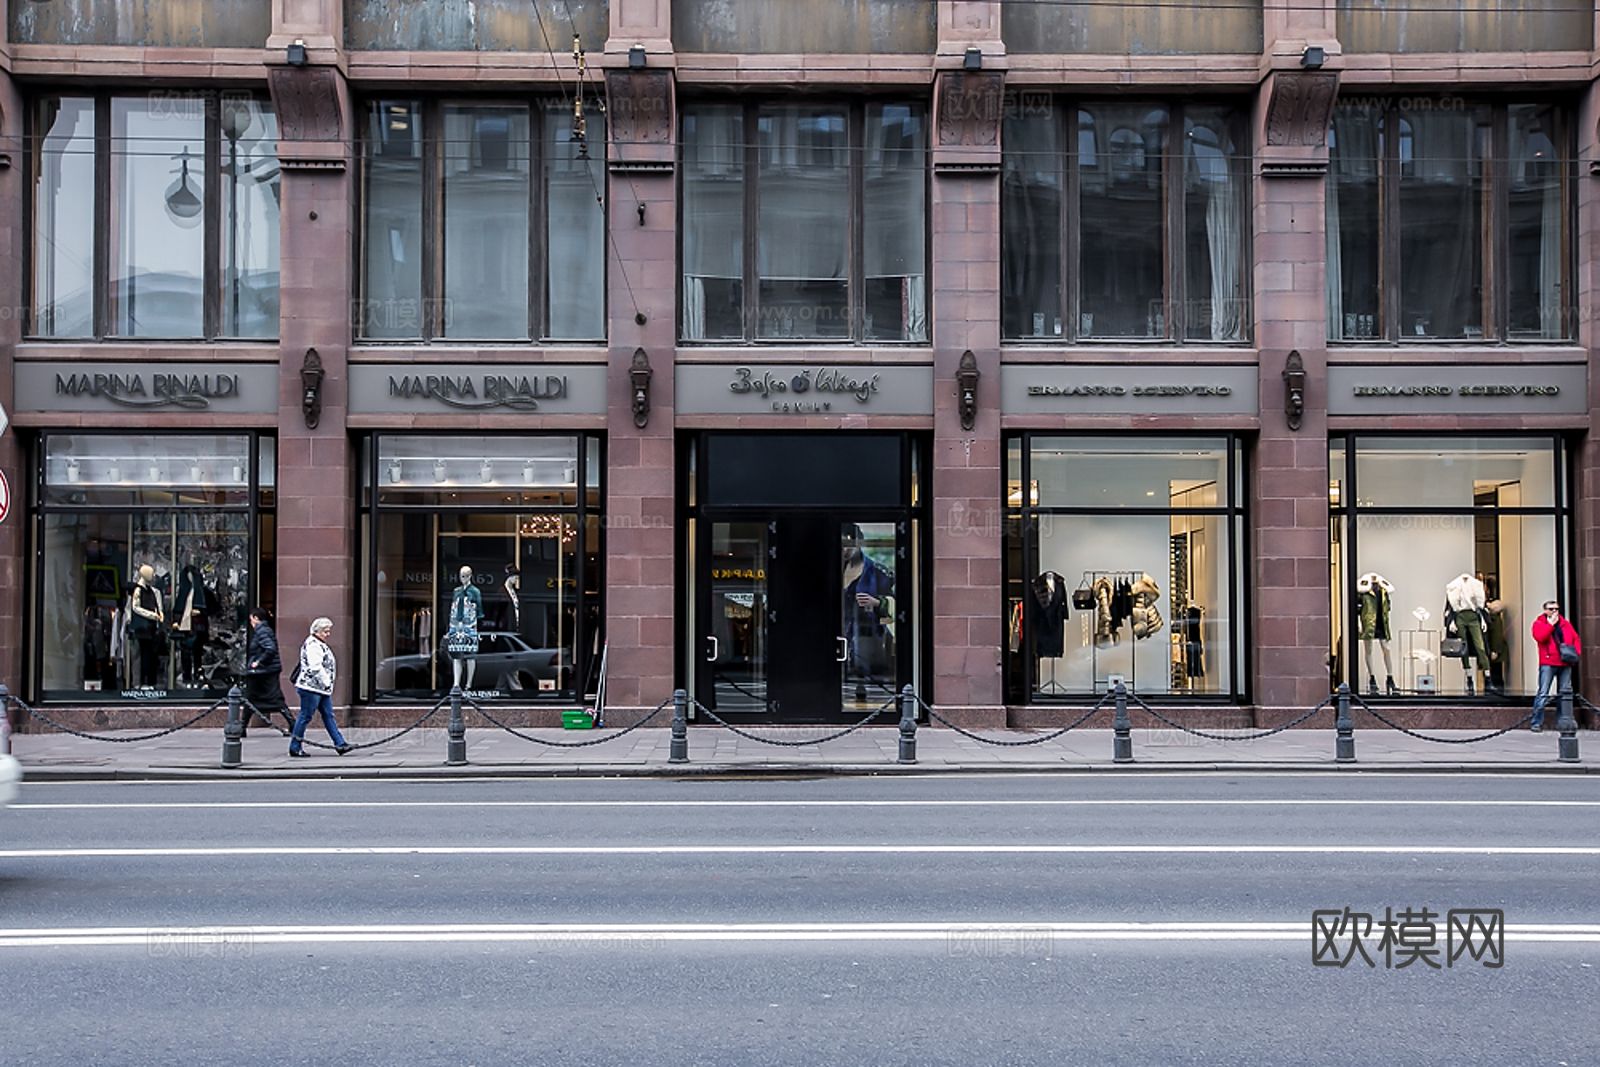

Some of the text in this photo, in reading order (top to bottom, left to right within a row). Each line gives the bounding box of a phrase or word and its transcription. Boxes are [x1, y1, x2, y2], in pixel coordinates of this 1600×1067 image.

[56, 371, 240, 407] MARINA RINALDI
[388, 374, 568, 408] MARINA RINALDI
[1028, 384, 1126, 397] ERMANNO
[1353, 384, 1561, 397] ERMANNO SCERVINO
